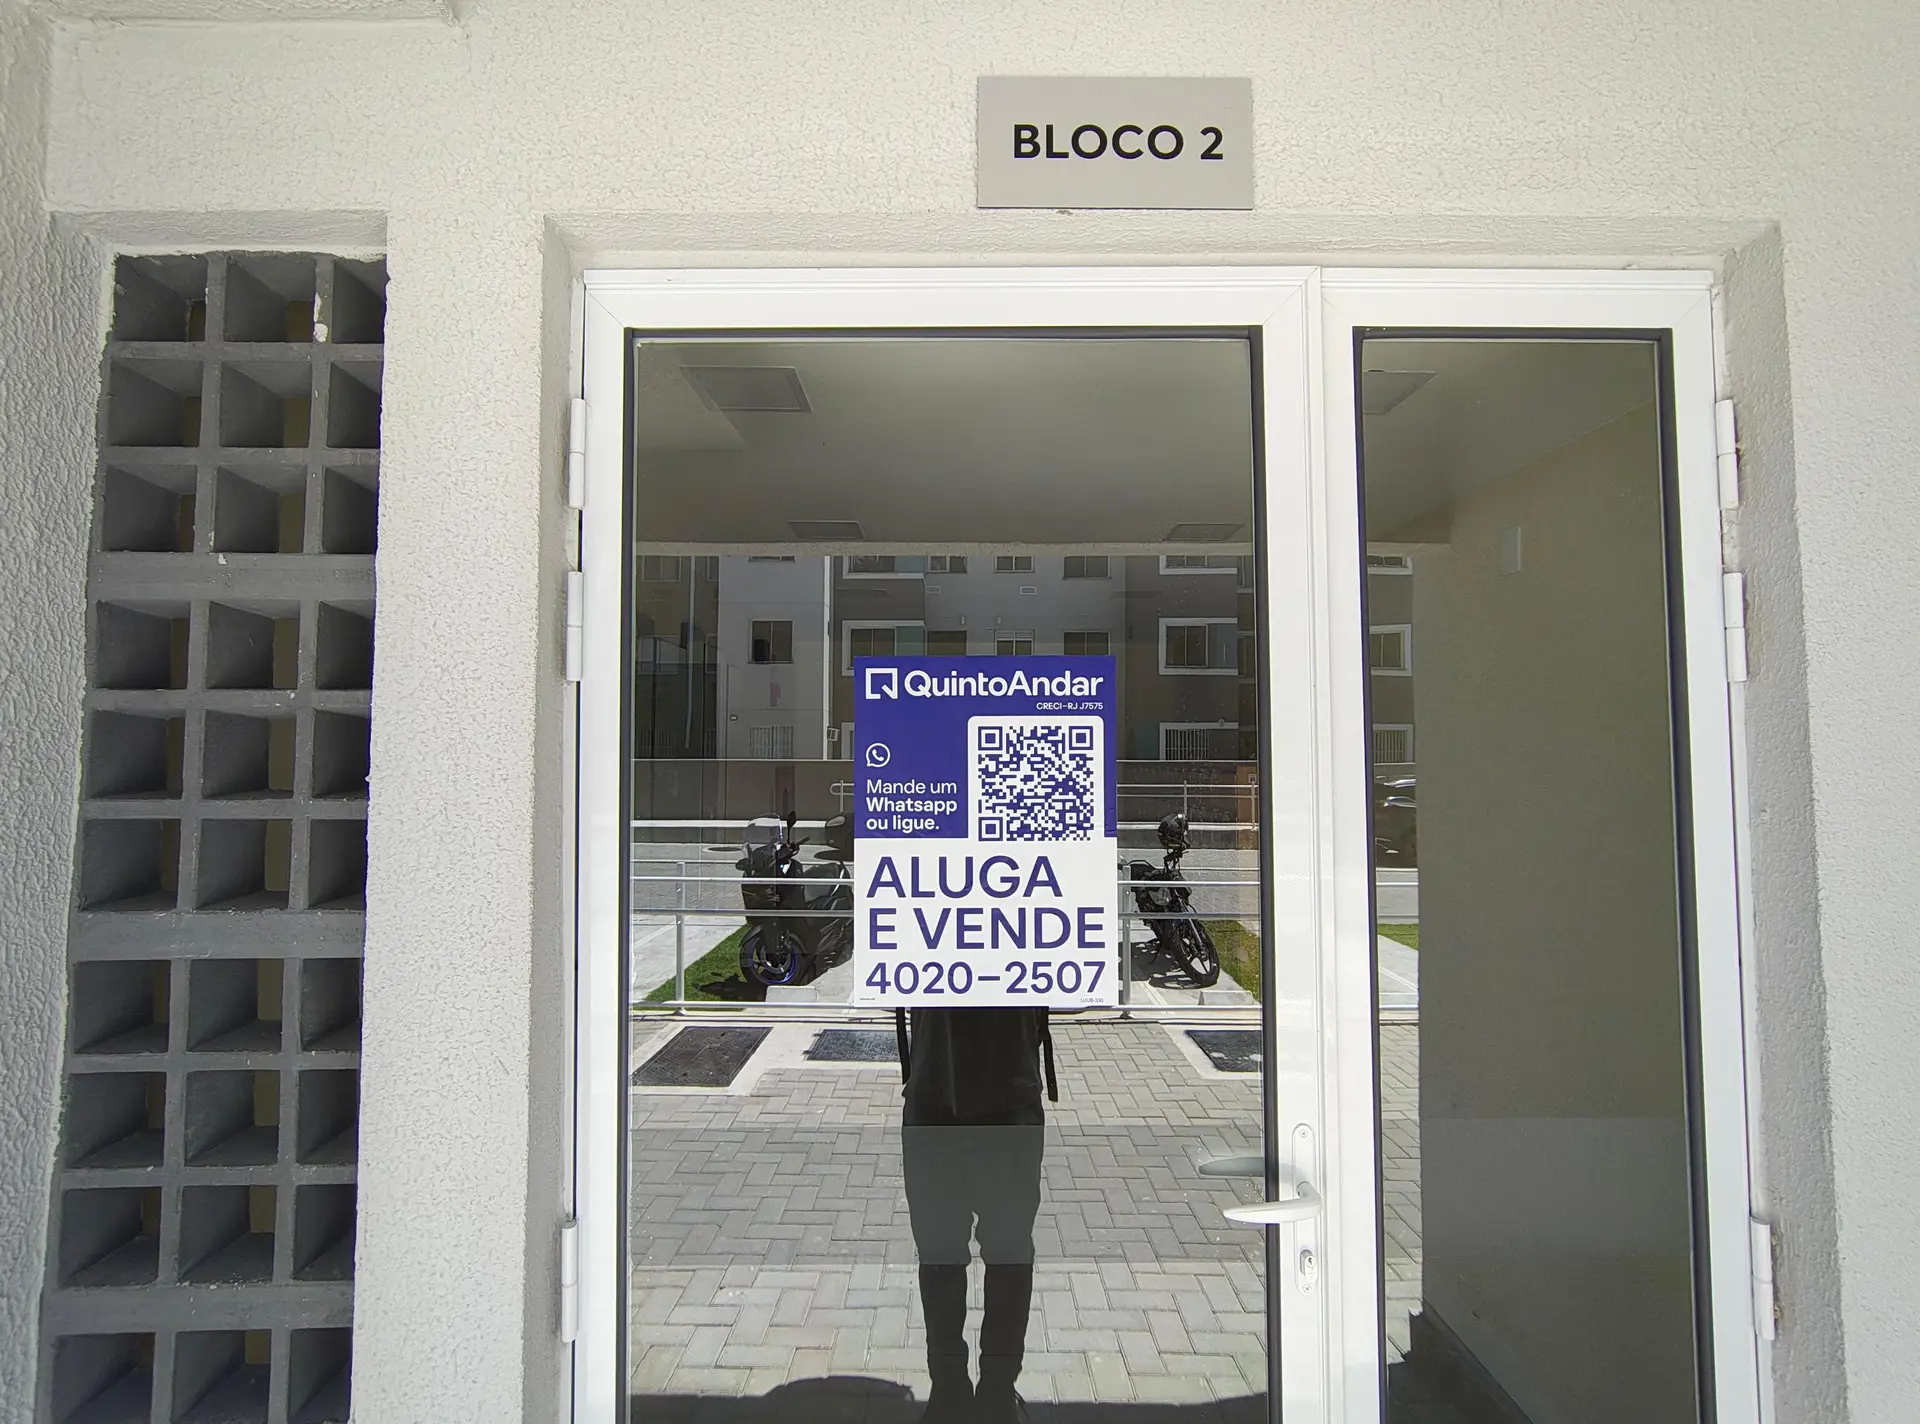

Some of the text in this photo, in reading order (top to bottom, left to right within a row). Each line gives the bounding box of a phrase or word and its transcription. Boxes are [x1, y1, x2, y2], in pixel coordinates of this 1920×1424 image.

[1013, 123, 1224, 160] BLOCO 2
[904, 669, 1104, 700] QuintoAndar
[1036, 702, 1104, 710] CRECI-RJ J7575
[866, 779, 957, 794] Mande um
[865, 797, 958, 816] Whatsapp
[866, 814, 940, 834] ou ligue.
[866, 855, 1063, 899] ALUGA
[869, 906, 1106, 950] E VENDE
[865, 960, 1106, 995] 4020-2507
